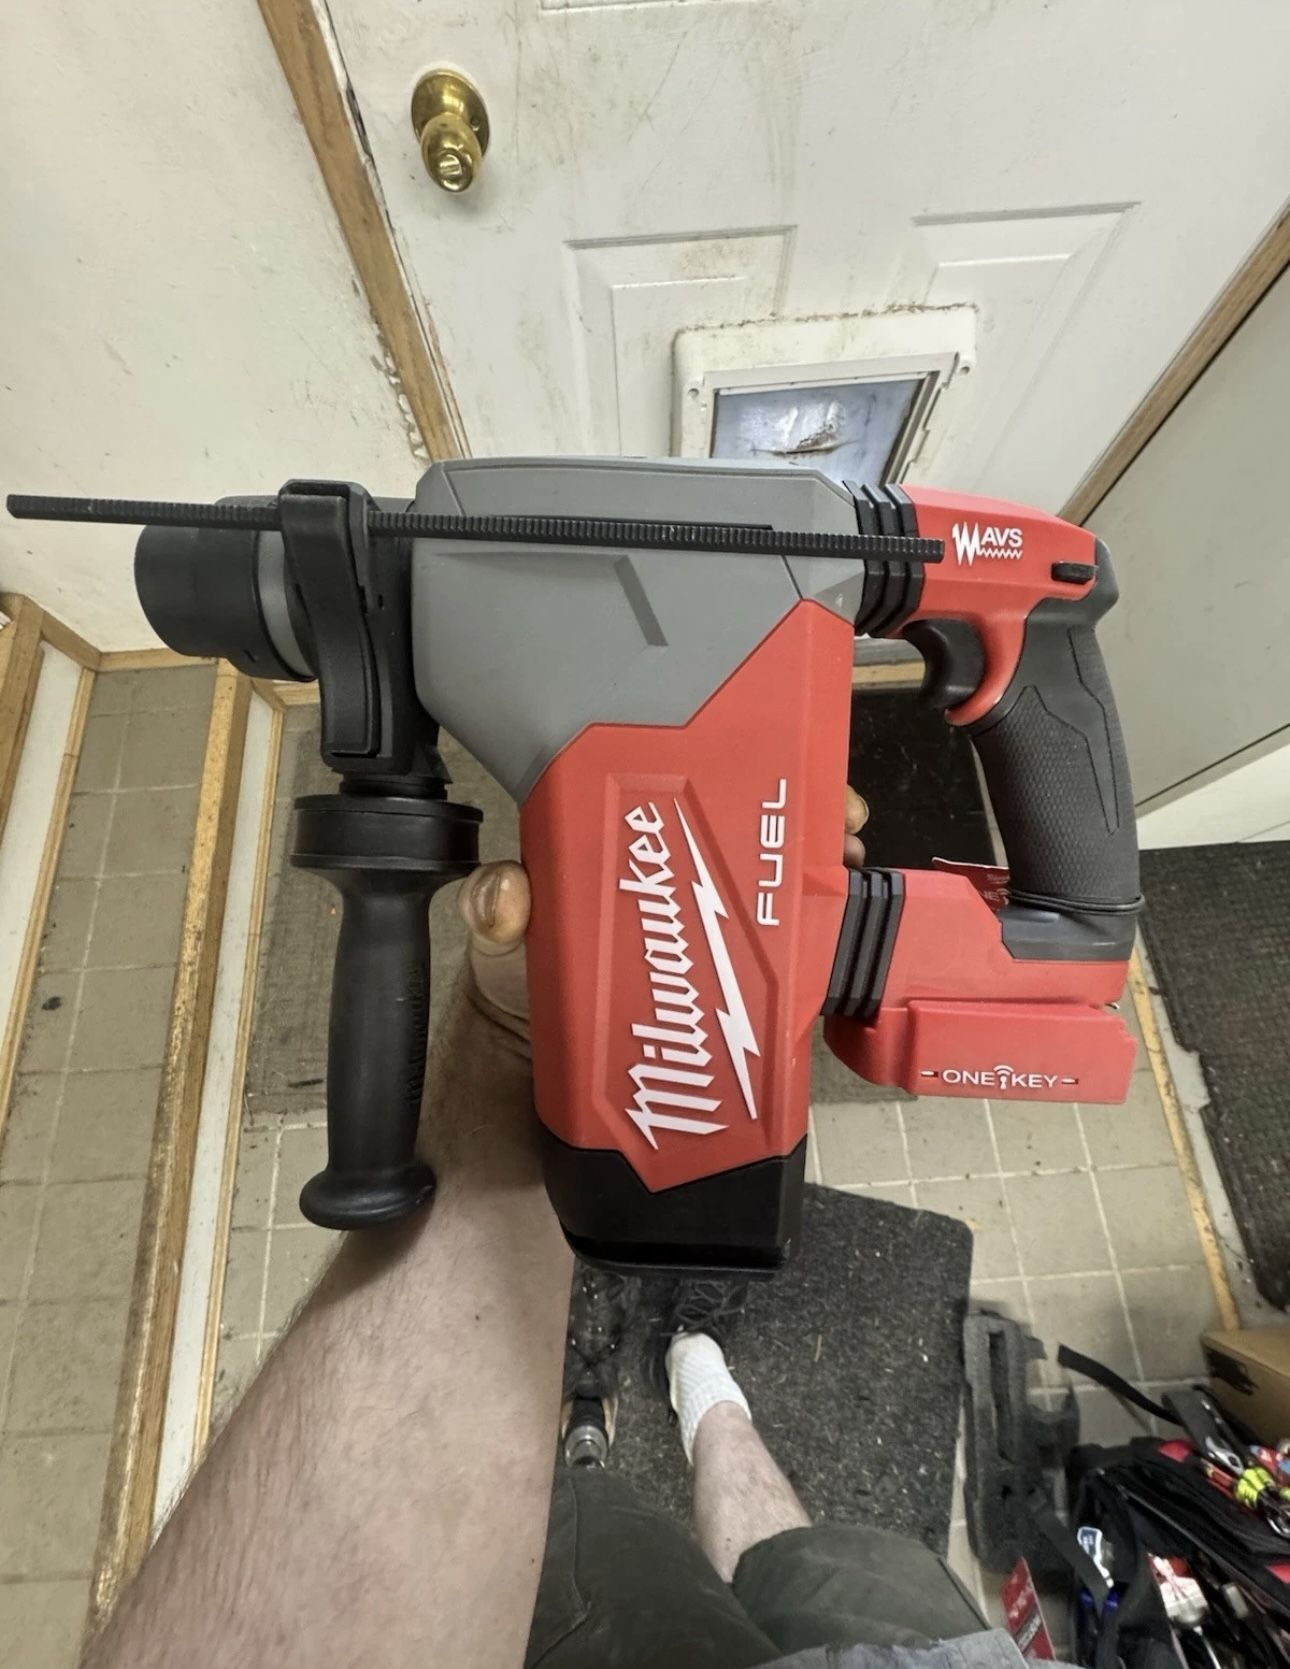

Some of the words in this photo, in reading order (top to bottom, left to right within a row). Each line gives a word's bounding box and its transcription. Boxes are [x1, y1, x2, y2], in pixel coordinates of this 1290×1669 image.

[757, 778, 787, 926] FUEL
[619, 802, 729, 1151] Milwaukee
[942, 1069, 995, 1086] ONE
[1011, 1071, 1058, 1088] KEY
